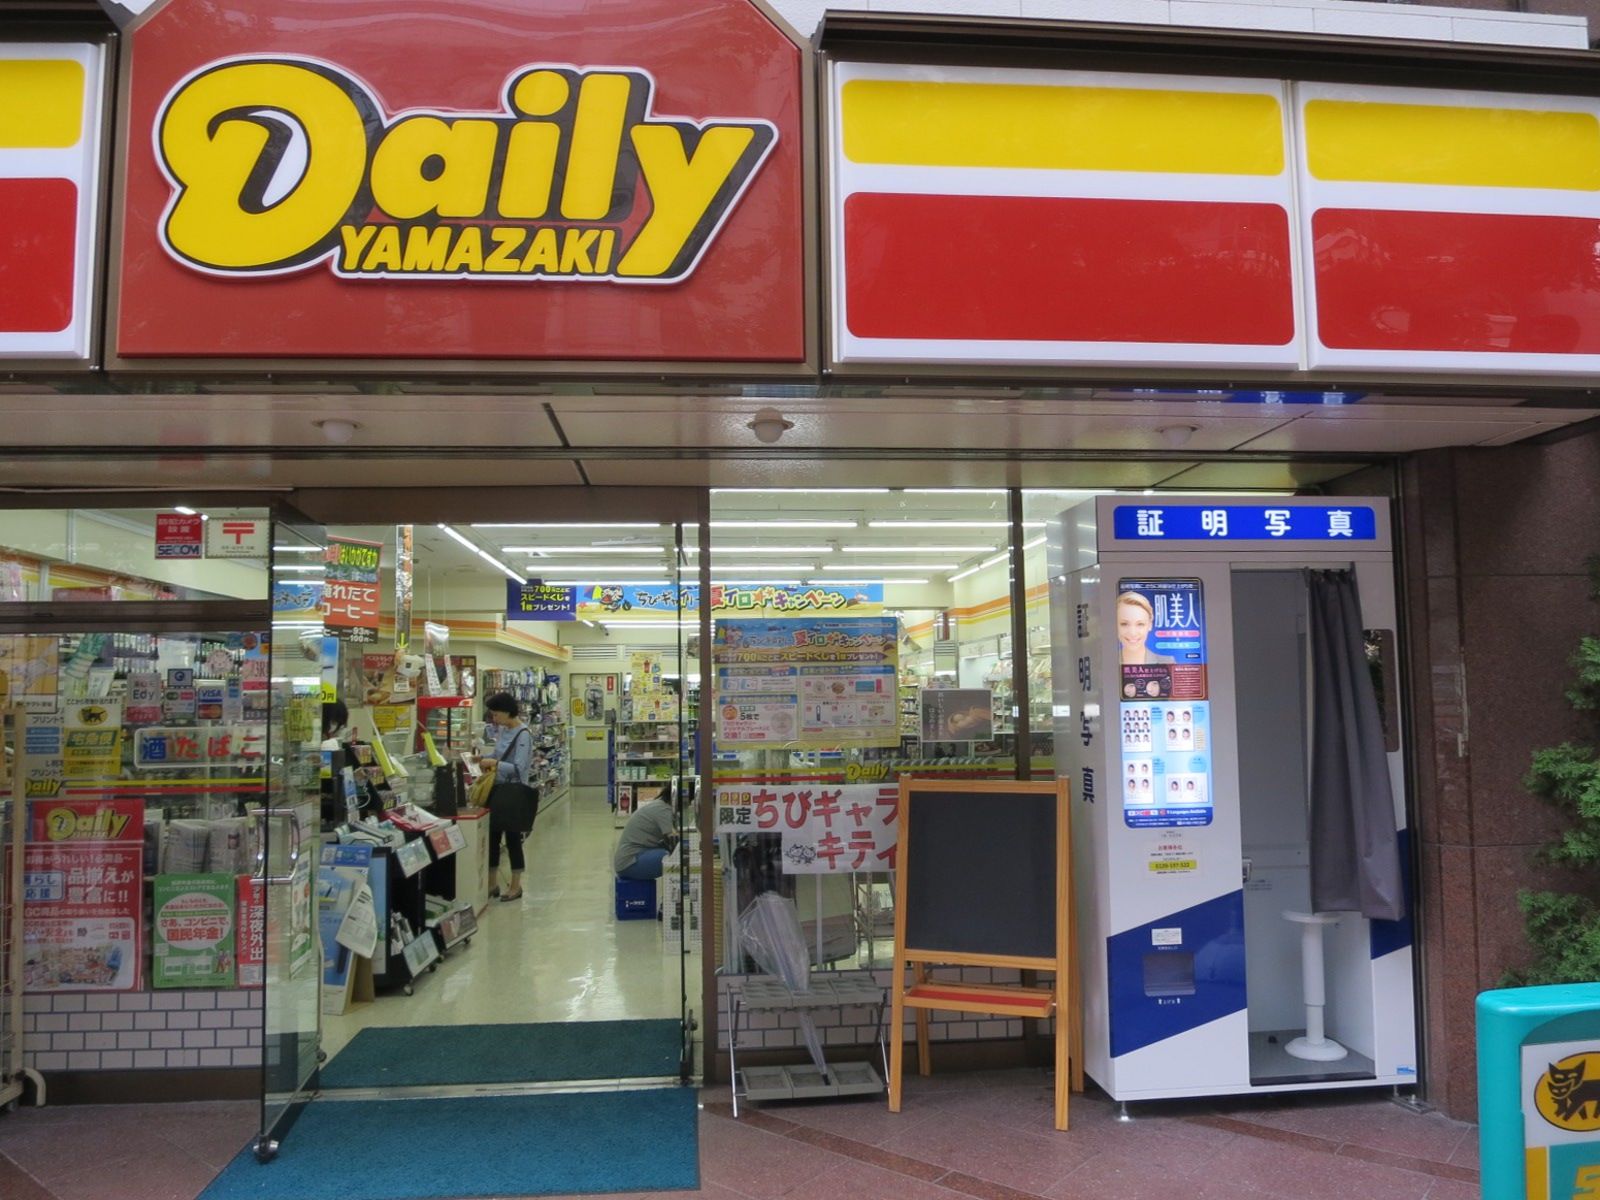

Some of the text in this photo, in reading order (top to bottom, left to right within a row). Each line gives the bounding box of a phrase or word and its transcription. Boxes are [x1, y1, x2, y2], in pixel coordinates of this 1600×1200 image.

[156, 58, 778, 283] Daily
[340, 225, 615, 274] YAMAZAKI
[1137, 510, 1355, 537] 証明写真
[158, 545, 200, 555] SECOM
[321, 603, 375, 619] コーヒー
[1154, 593, 1200, 628] 肌美人
[133, 689, 155, 699] Edy
[143, 735, 261, 760] 酒 たばこ
[847, 764, 889, 781] Daily
[46, 807, 131, 841] Daily
[719, 807, 752, 825] 限定
